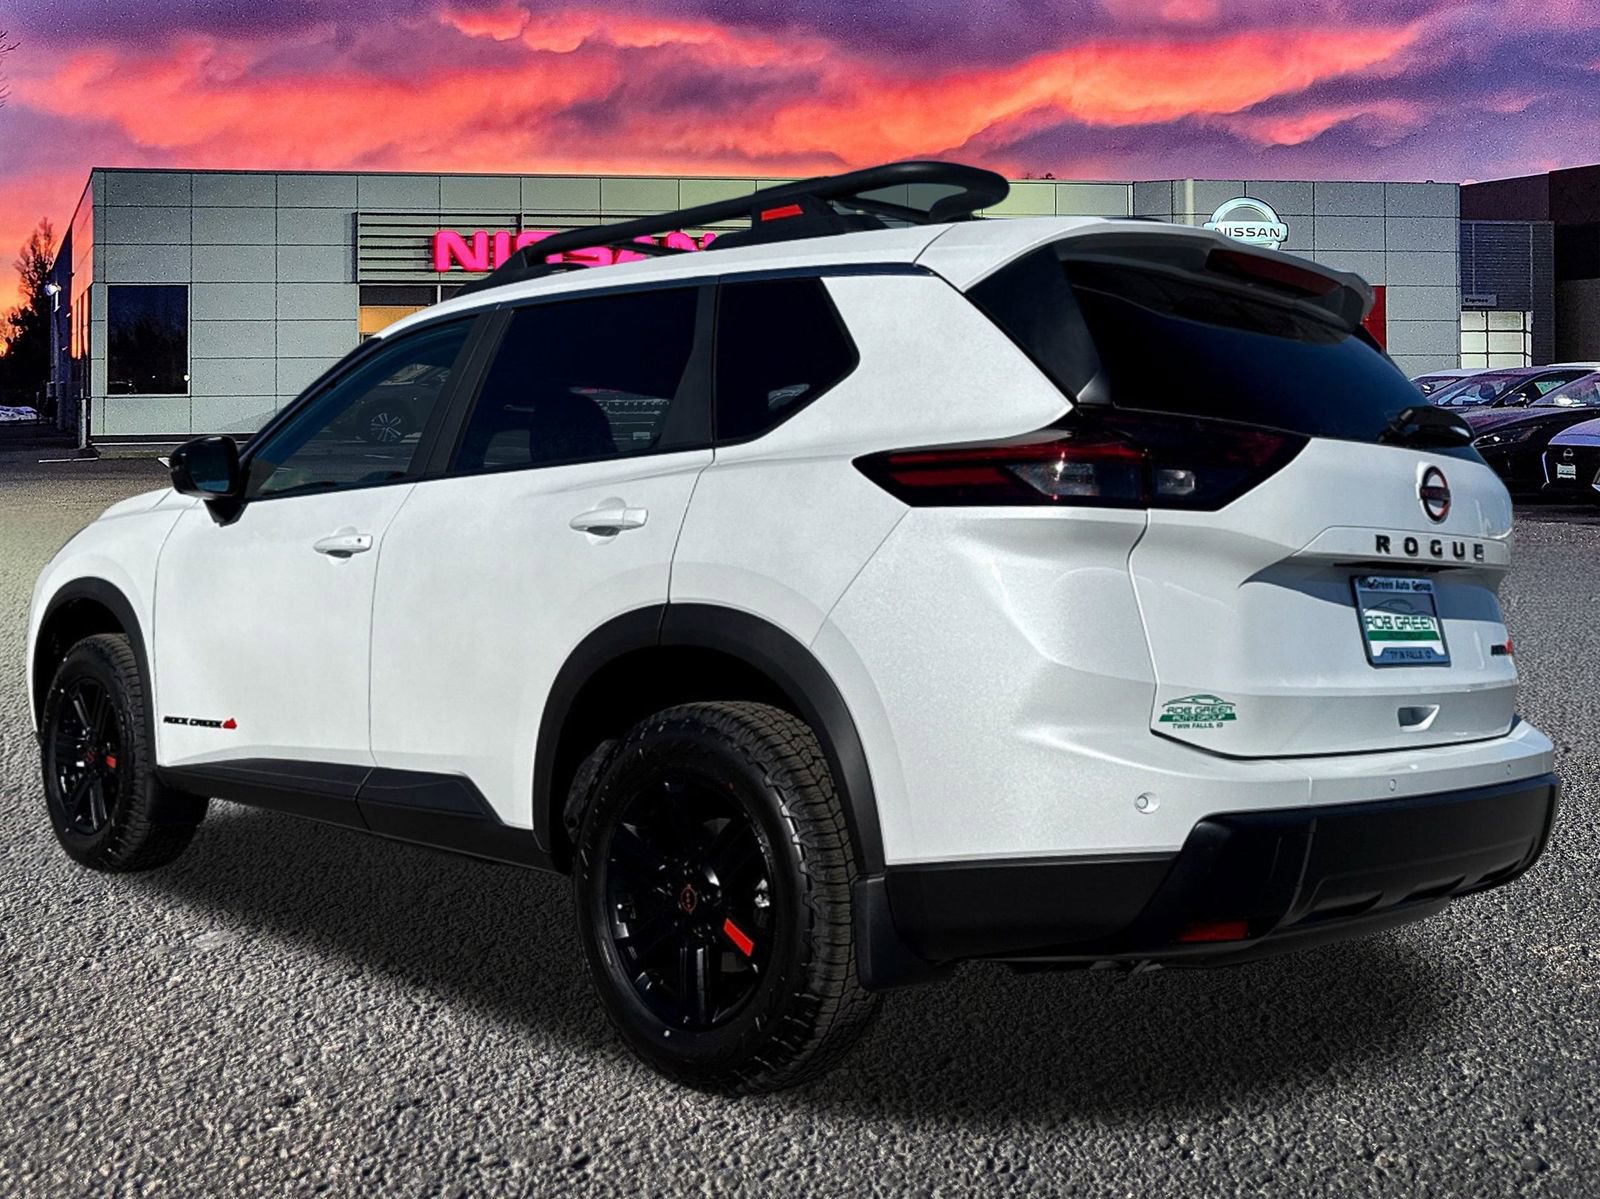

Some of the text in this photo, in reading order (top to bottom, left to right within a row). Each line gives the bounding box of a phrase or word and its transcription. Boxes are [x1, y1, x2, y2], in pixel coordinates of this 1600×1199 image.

[1214, 227, 1280, 238] NISSAN
[1375, 534, 1485, 561] ROGUE
[1365, 615, 1437, 630] ROB GREEN
[1166, 706, 1233, 714] ROB GREEN
[163, 715, 222, 728] ROCK CREEK
